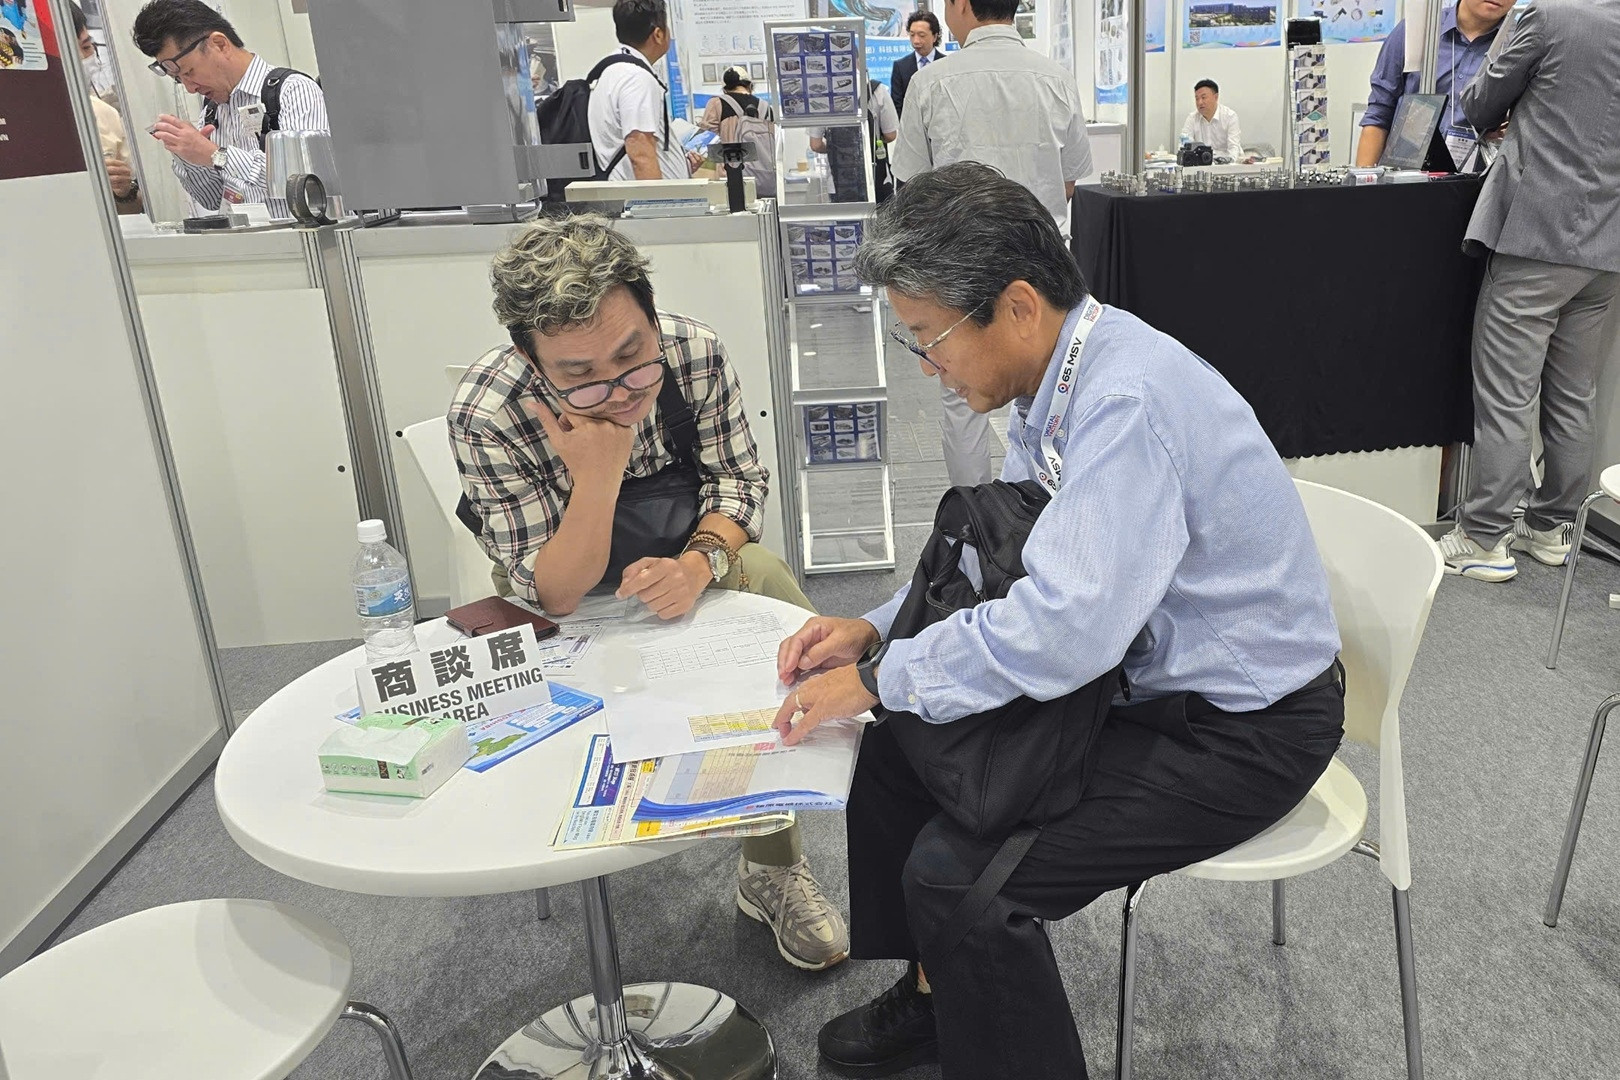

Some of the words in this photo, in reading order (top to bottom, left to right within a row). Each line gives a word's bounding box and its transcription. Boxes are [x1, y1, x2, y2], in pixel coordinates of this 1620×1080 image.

[1067, 337, 1082, 366] MSV
[371, 630, 528, 703] 商談席
[466, 667, 544, 702] MEETING
